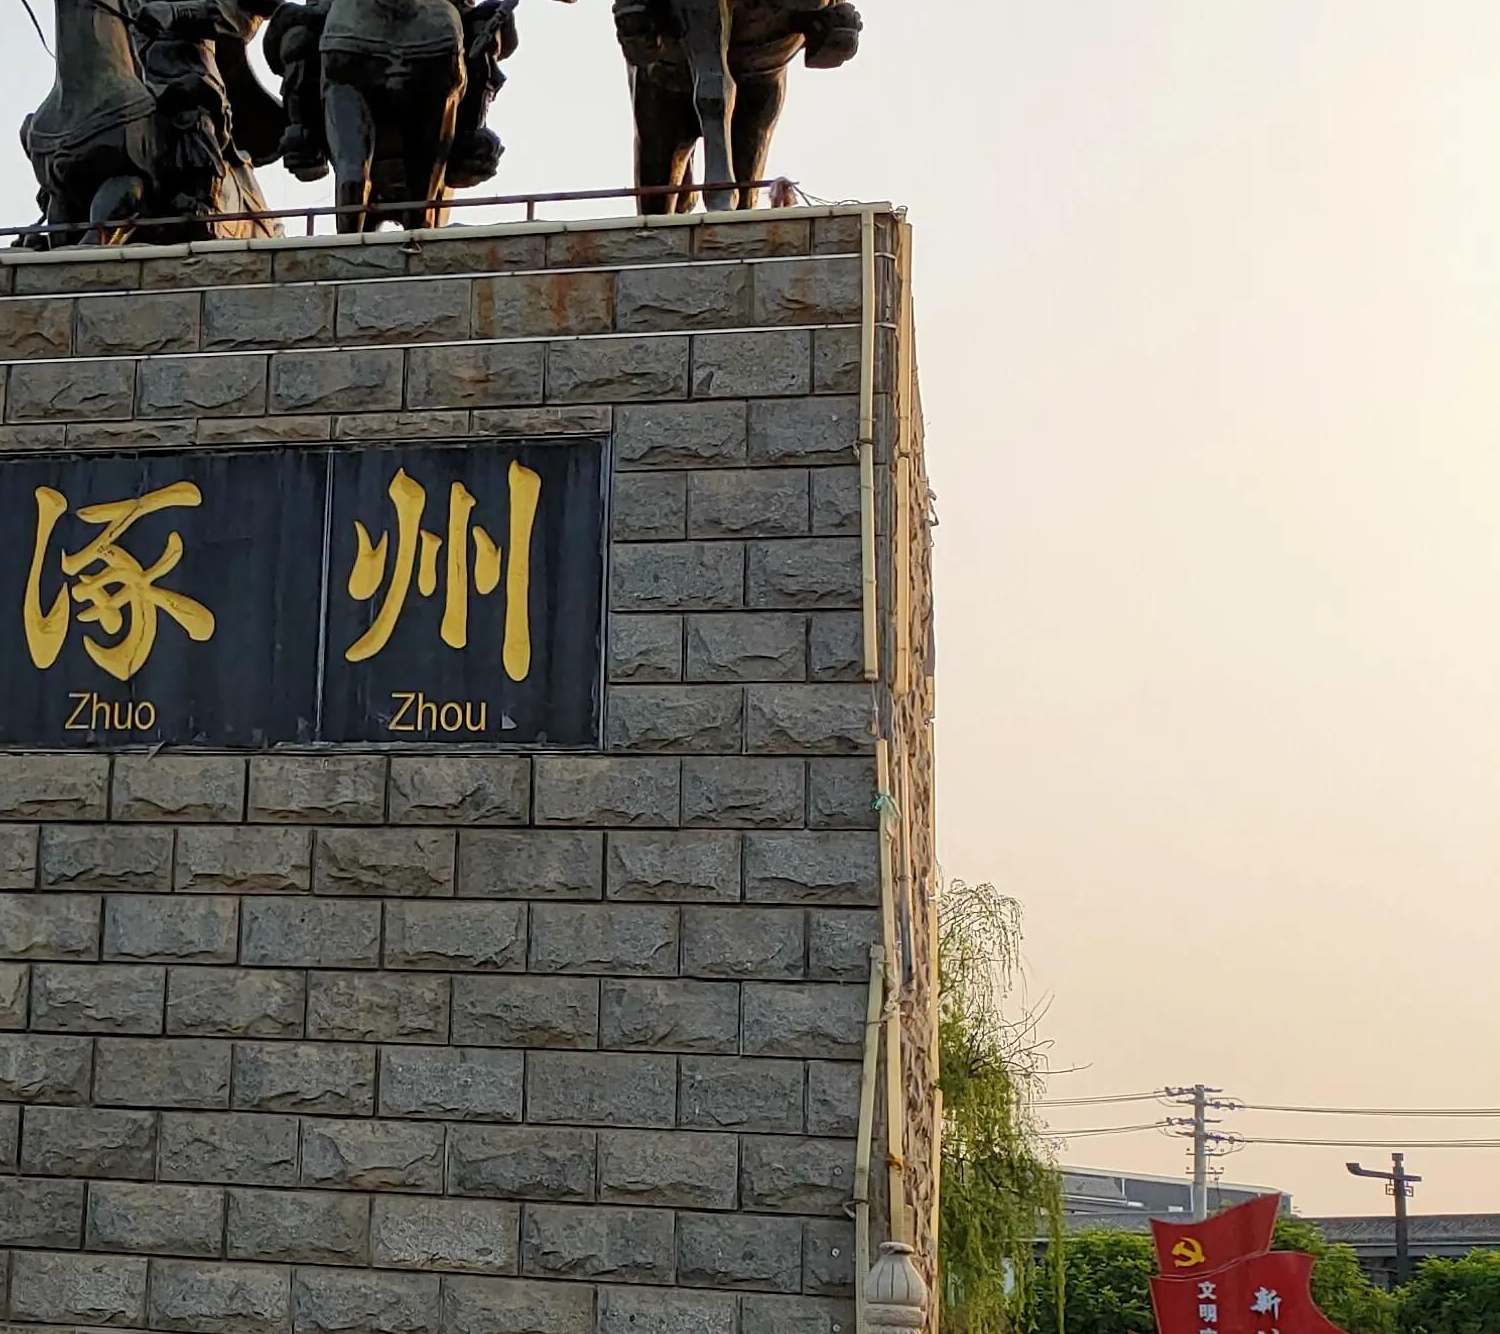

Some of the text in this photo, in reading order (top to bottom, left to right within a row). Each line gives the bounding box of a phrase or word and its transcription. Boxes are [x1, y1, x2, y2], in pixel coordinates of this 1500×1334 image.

[24, 460, 542, 682] 涿州
[64, 691, 487, 732] Zhuo Zhou
